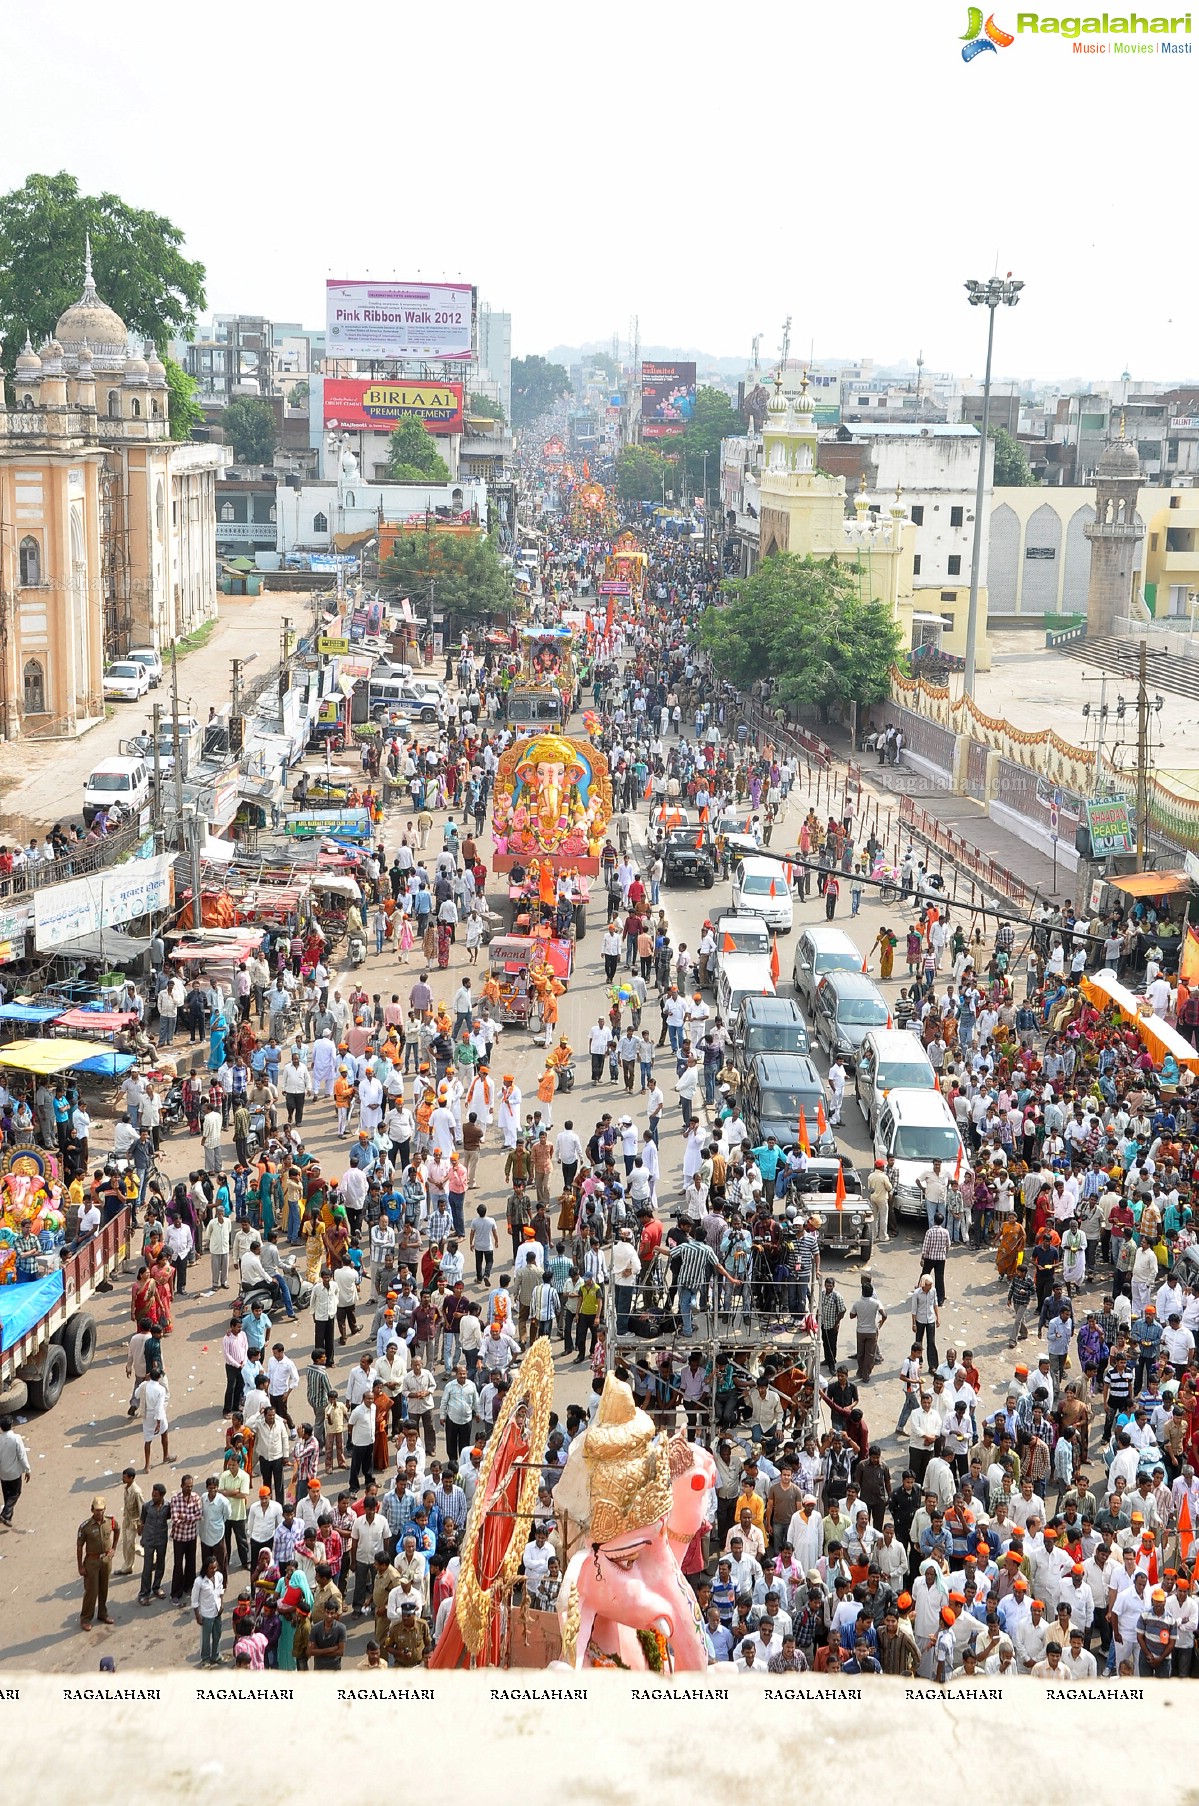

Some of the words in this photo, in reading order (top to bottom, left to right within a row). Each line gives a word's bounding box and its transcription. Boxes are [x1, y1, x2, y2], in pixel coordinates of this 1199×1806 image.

[336, 309, 360, 321] Pink
[363, 310, 401, 323] Ribbon
[405, 311, 431, 324] Walk
[435, 312, 462, 324] 2012
[371, 391, 425, 405] BIRLA
[430, 394, 450, 406] A1
[370, 407, 412, 416] PREMIUM
[415, 409, 451, 418] CEMENT
[1091, 807, 1127, 827] SHAADAN
[1093, 822, 1128, 838] PEARLS
[491, 947, 527, 958] Anand
